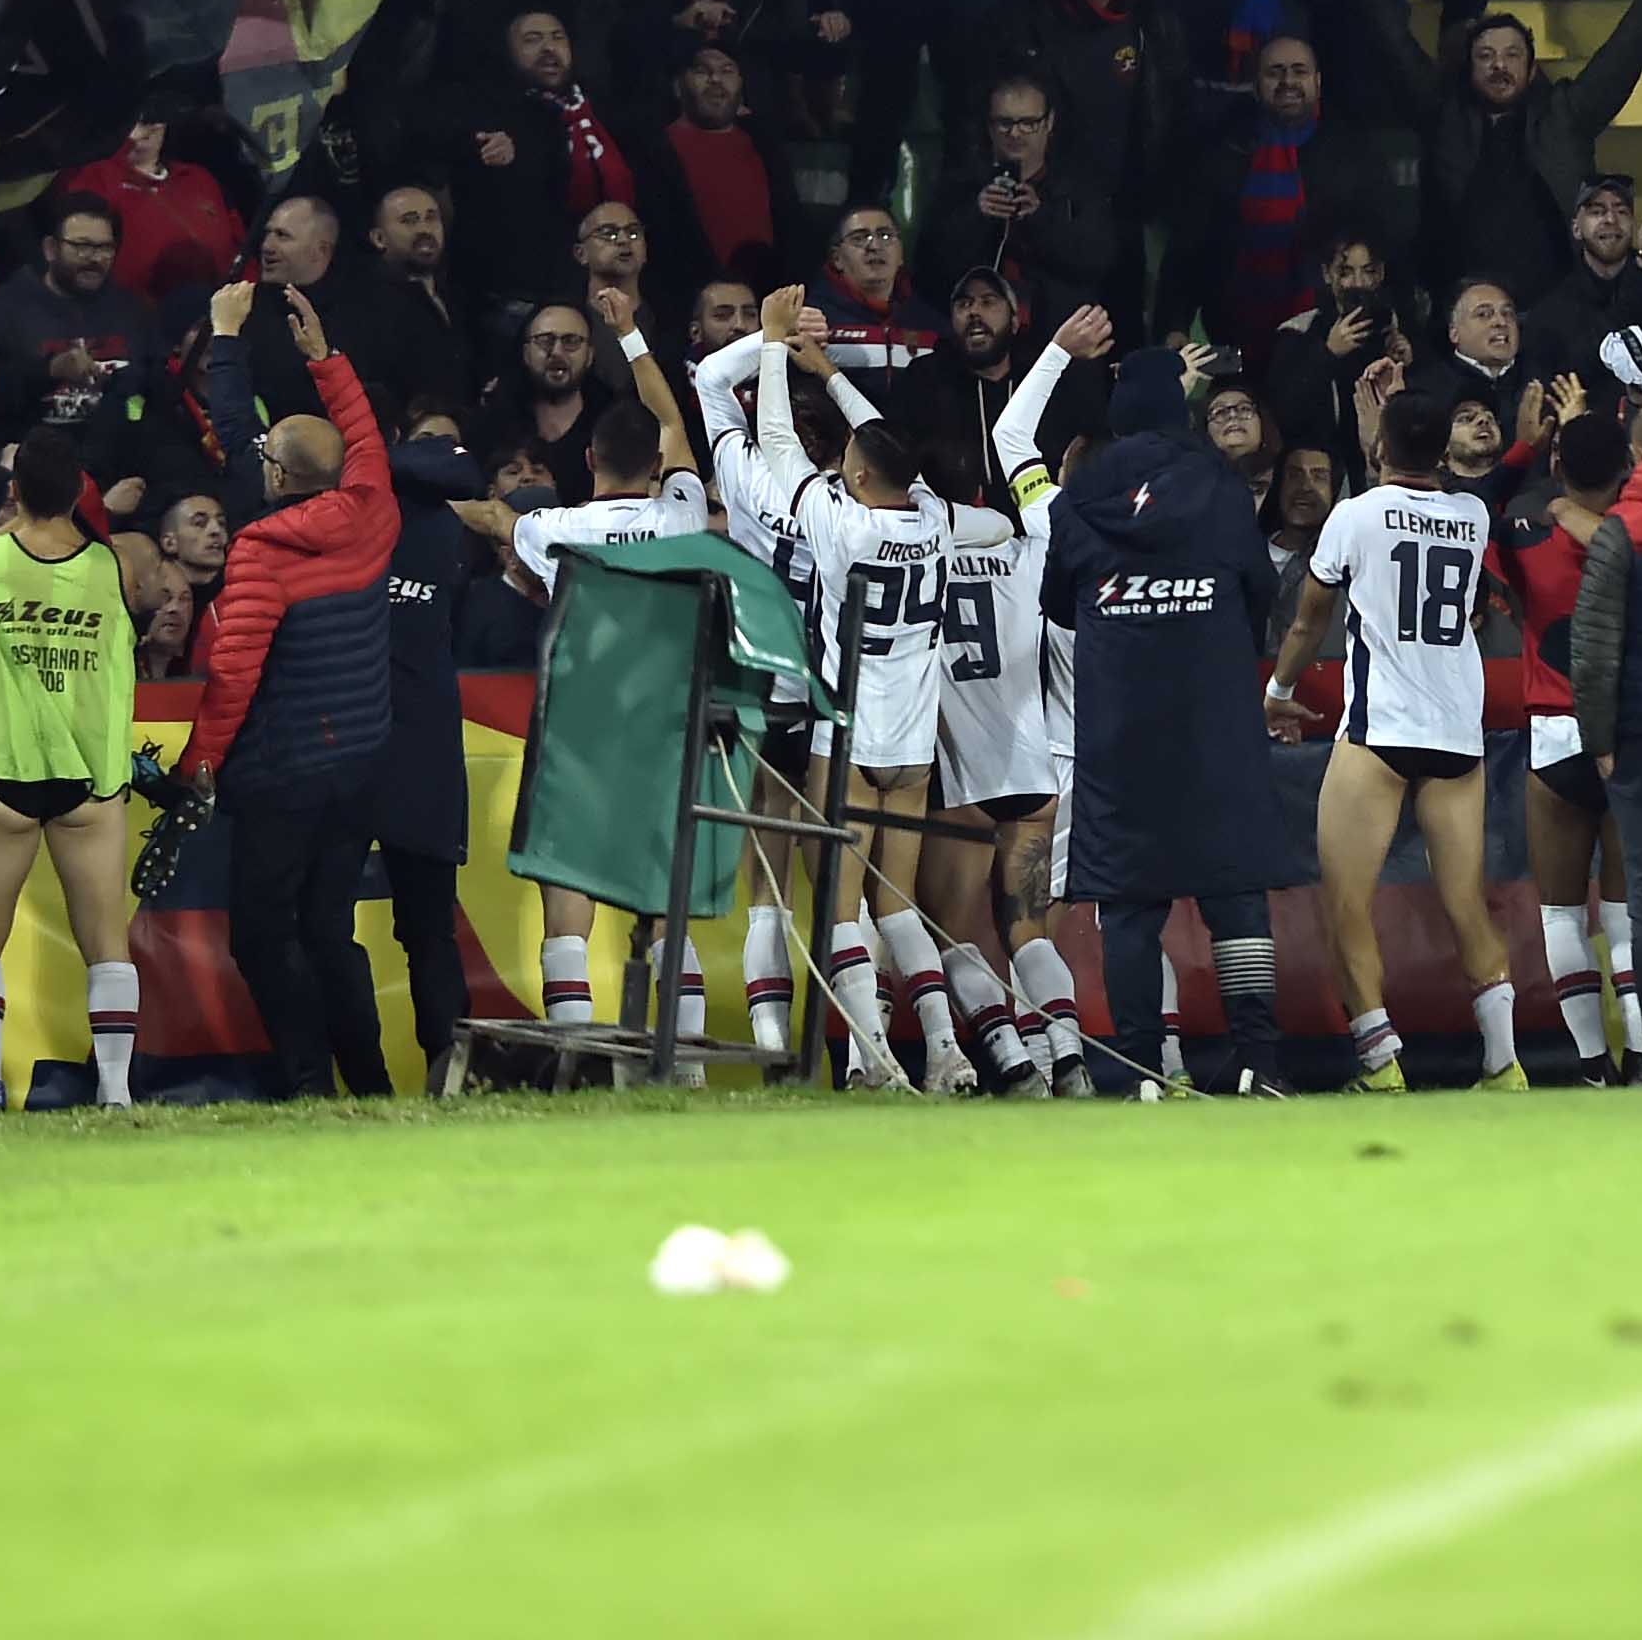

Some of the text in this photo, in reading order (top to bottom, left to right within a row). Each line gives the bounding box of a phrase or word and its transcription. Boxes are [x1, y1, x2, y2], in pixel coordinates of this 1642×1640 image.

[1385, 509, 1476, 543] CLEMENTE
[1121, 574, 1217, 601] Zeus
[1391, 540, 1475, 647] 18
[18, 600, 103, 628] Zeus
[1100, 602, 1153, 616] veste
